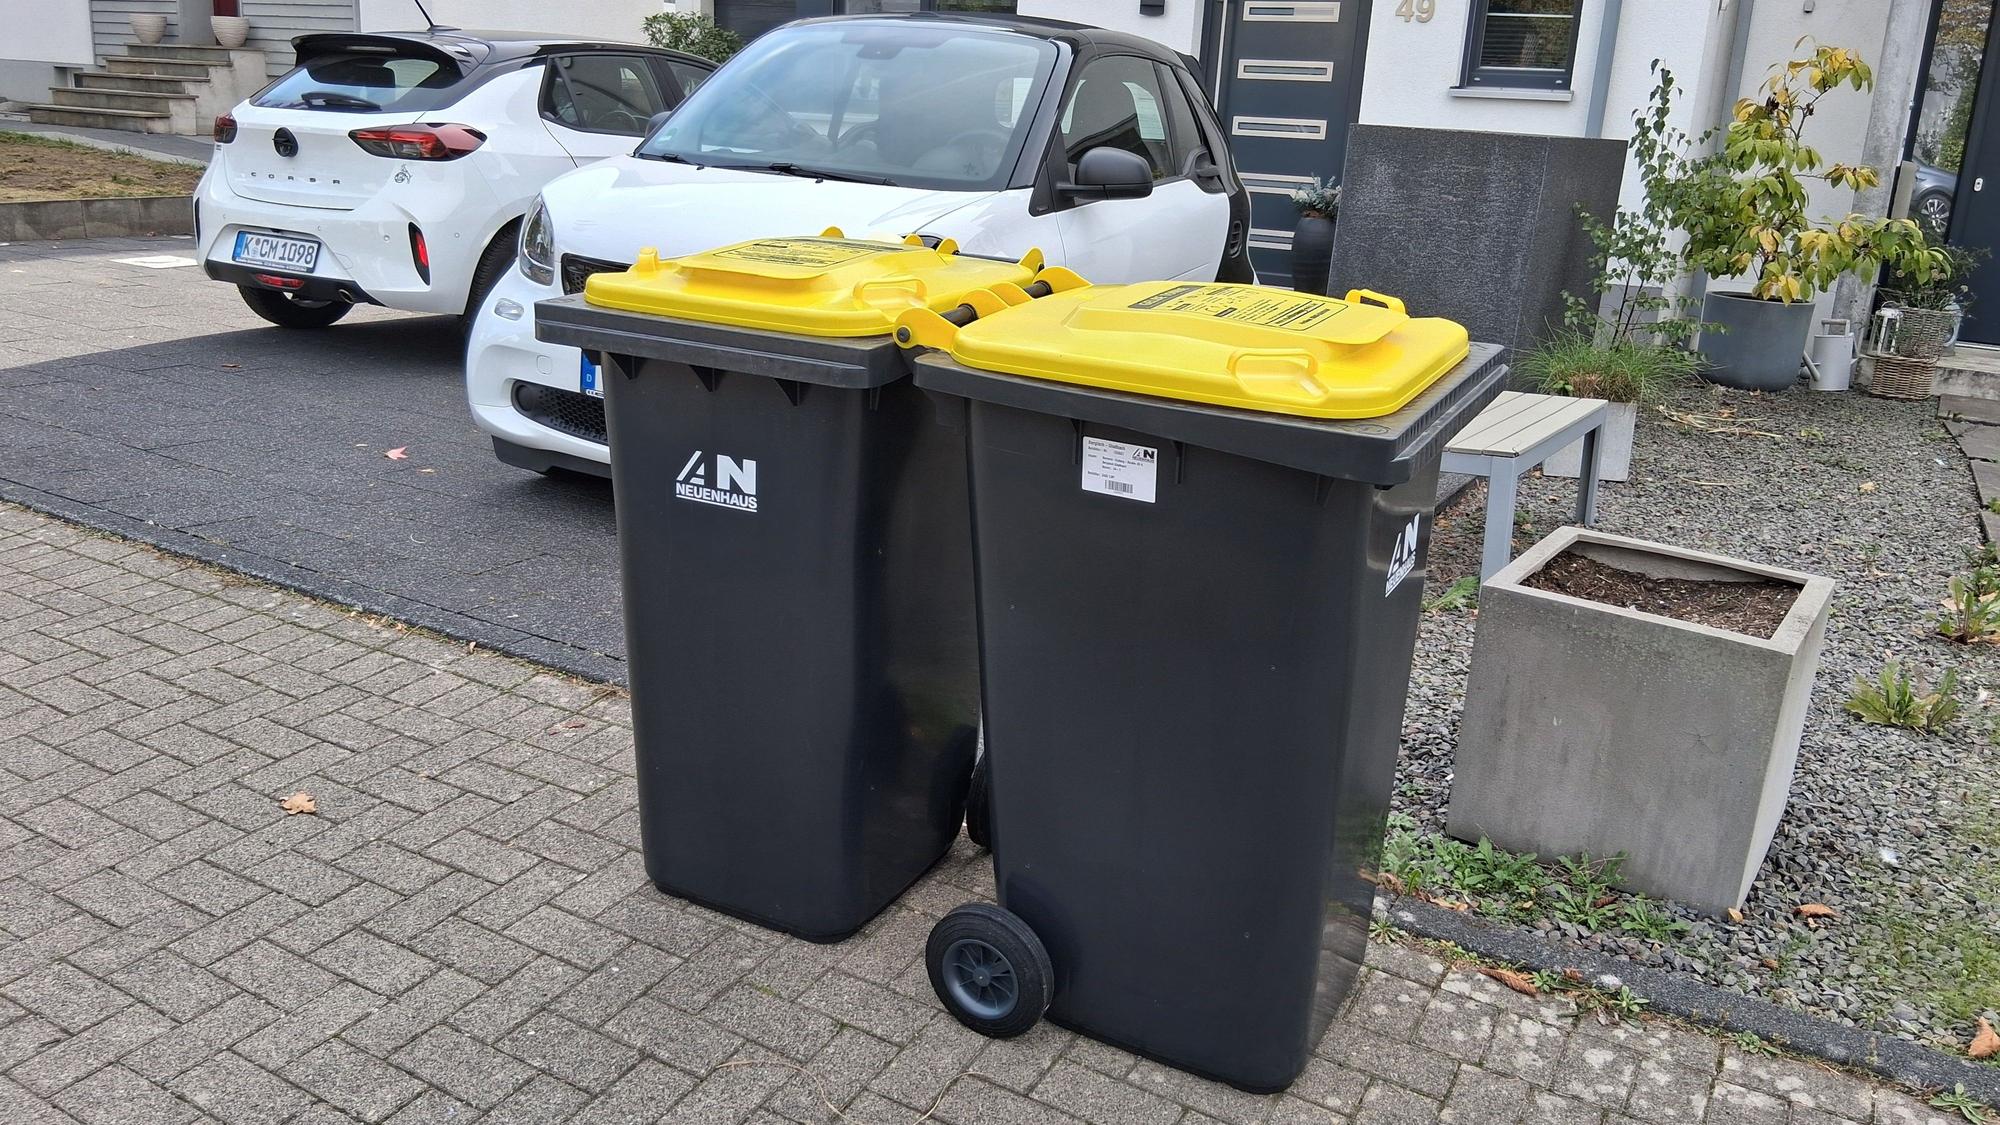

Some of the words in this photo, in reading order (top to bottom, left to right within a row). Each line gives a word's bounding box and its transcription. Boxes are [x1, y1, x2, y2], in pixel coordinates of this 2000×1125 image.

[1395, 0, 1435, 23] 49
[242, 236, 254, 256] K
[586, 373, 593, 383] D
[676, 481, 758, 510] NEUENHAUS
